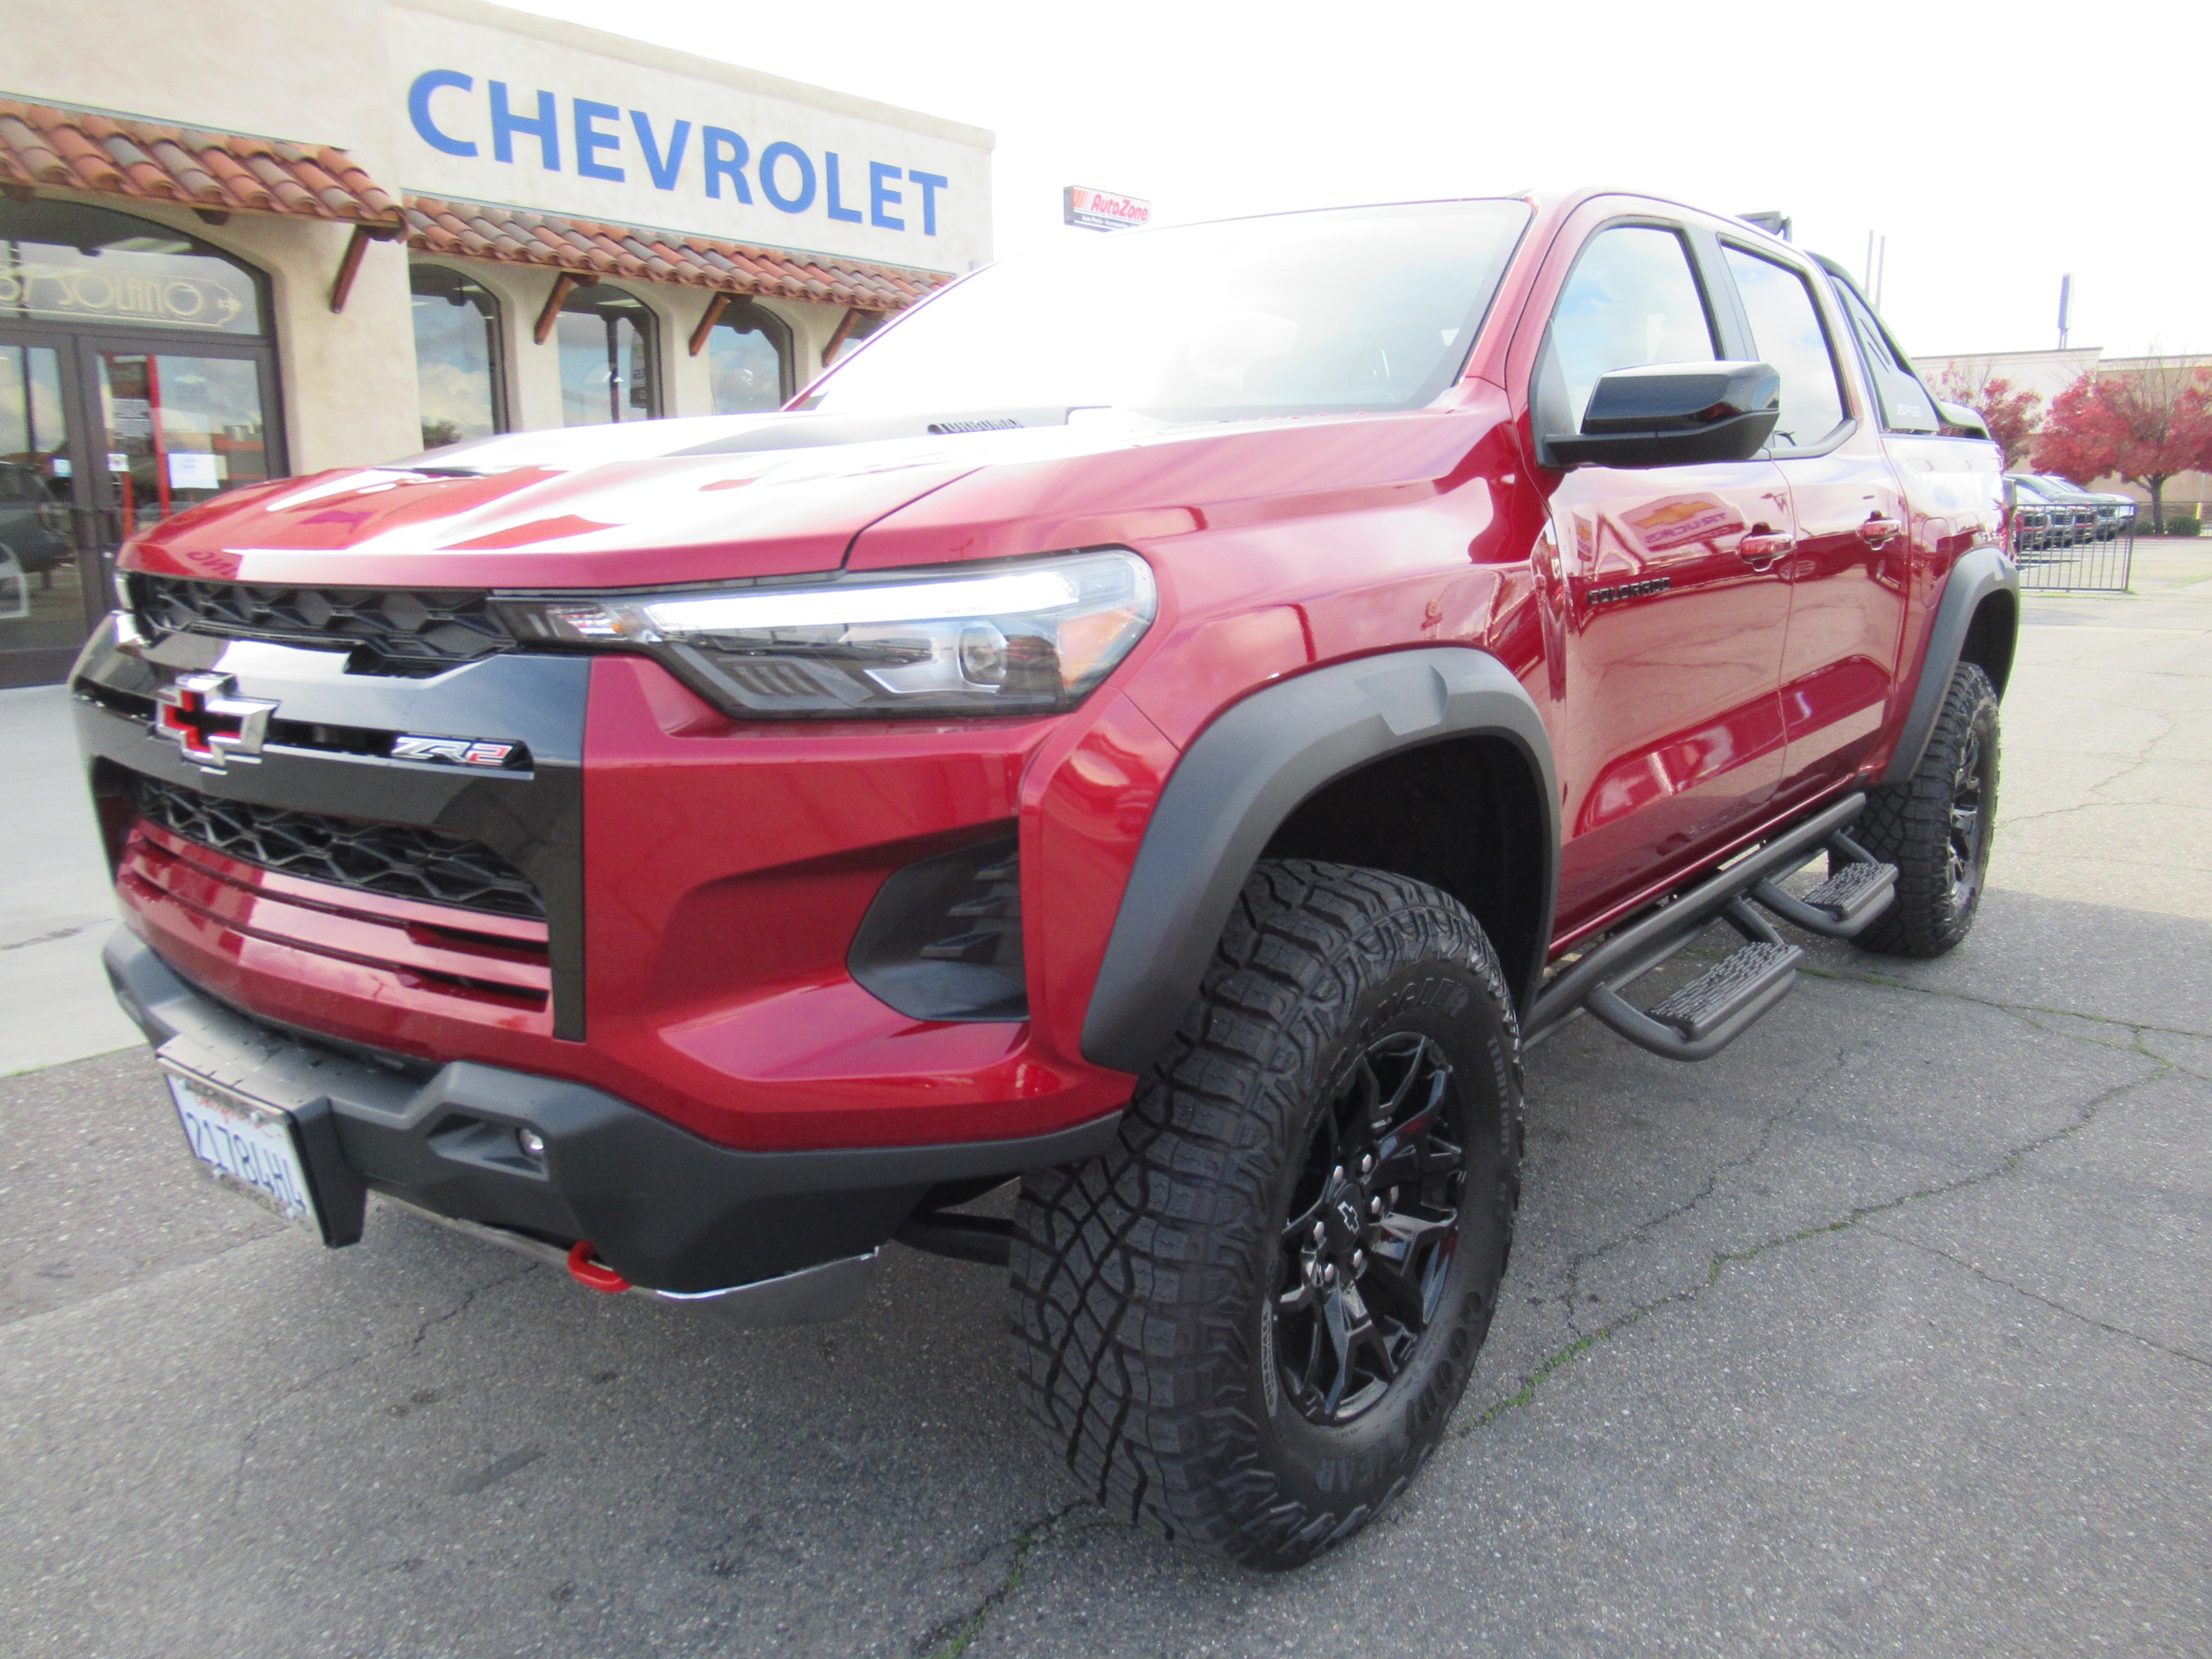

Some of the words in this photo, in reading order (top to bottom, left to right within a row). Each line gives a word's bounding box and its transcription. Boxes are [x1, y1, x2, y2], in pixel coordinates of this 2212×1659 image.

[408, 68, 948, 237] CHEVROLET
[1090, 193, 1149, 221] AutoZone
[1587, 577, 1671, 605] COLORADO
[391, 736, 513, 766] ZR2
